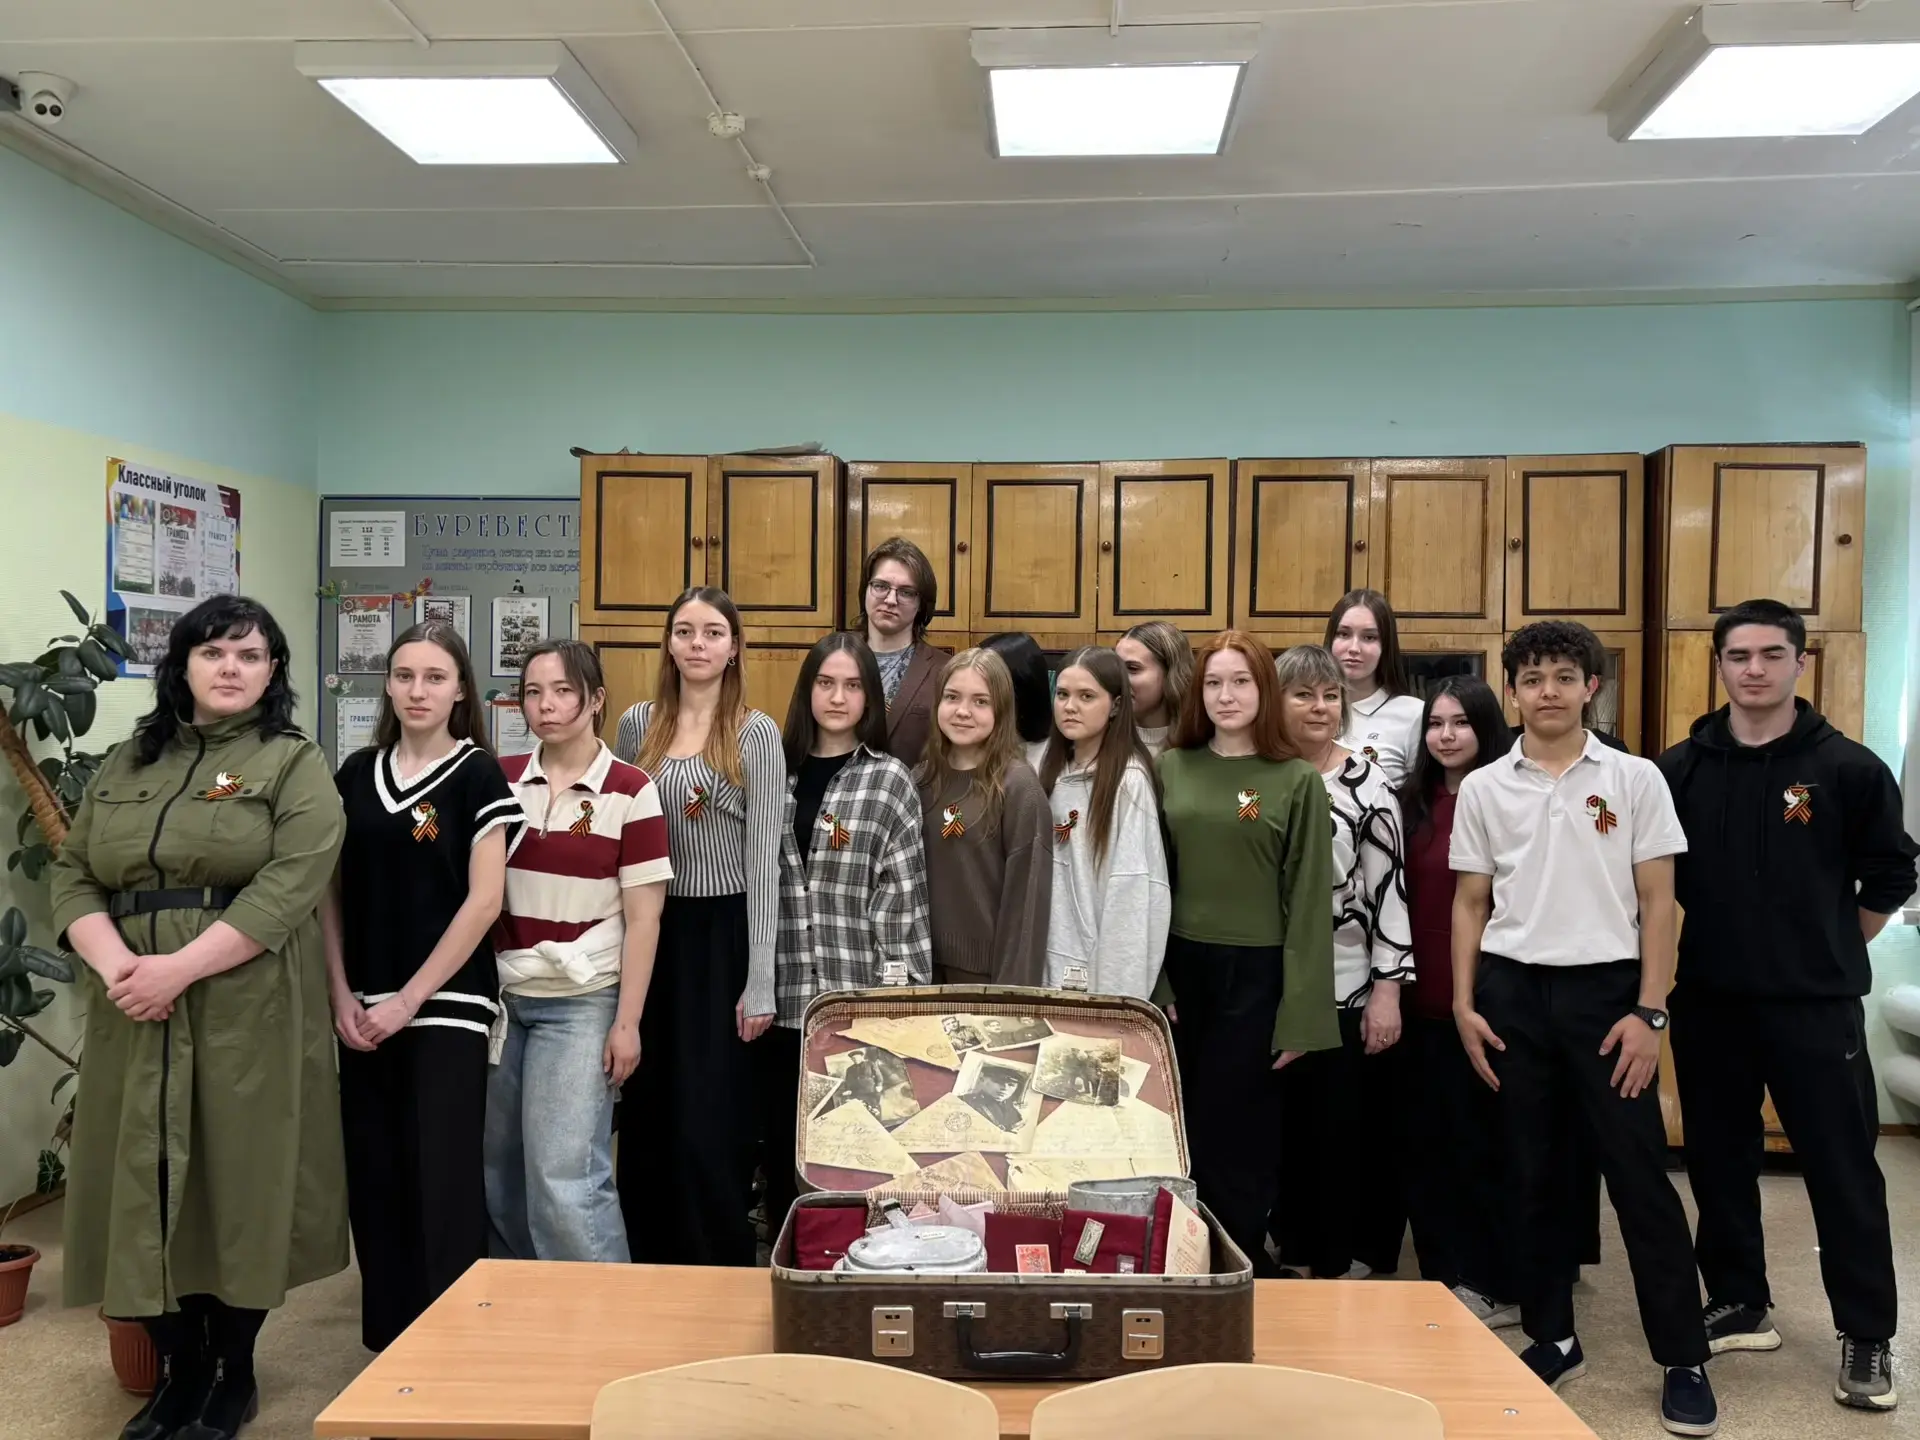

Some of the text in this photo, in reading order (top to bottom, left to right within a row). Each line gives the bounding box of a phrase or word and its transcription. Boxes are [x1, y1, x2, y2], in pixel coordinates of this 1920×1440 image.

[118, 464, 206, 502] Классный уголок
[166, 526, 190, 540] ГРАМОТА
[349, 614, 381, 623] ГРАМОТА
